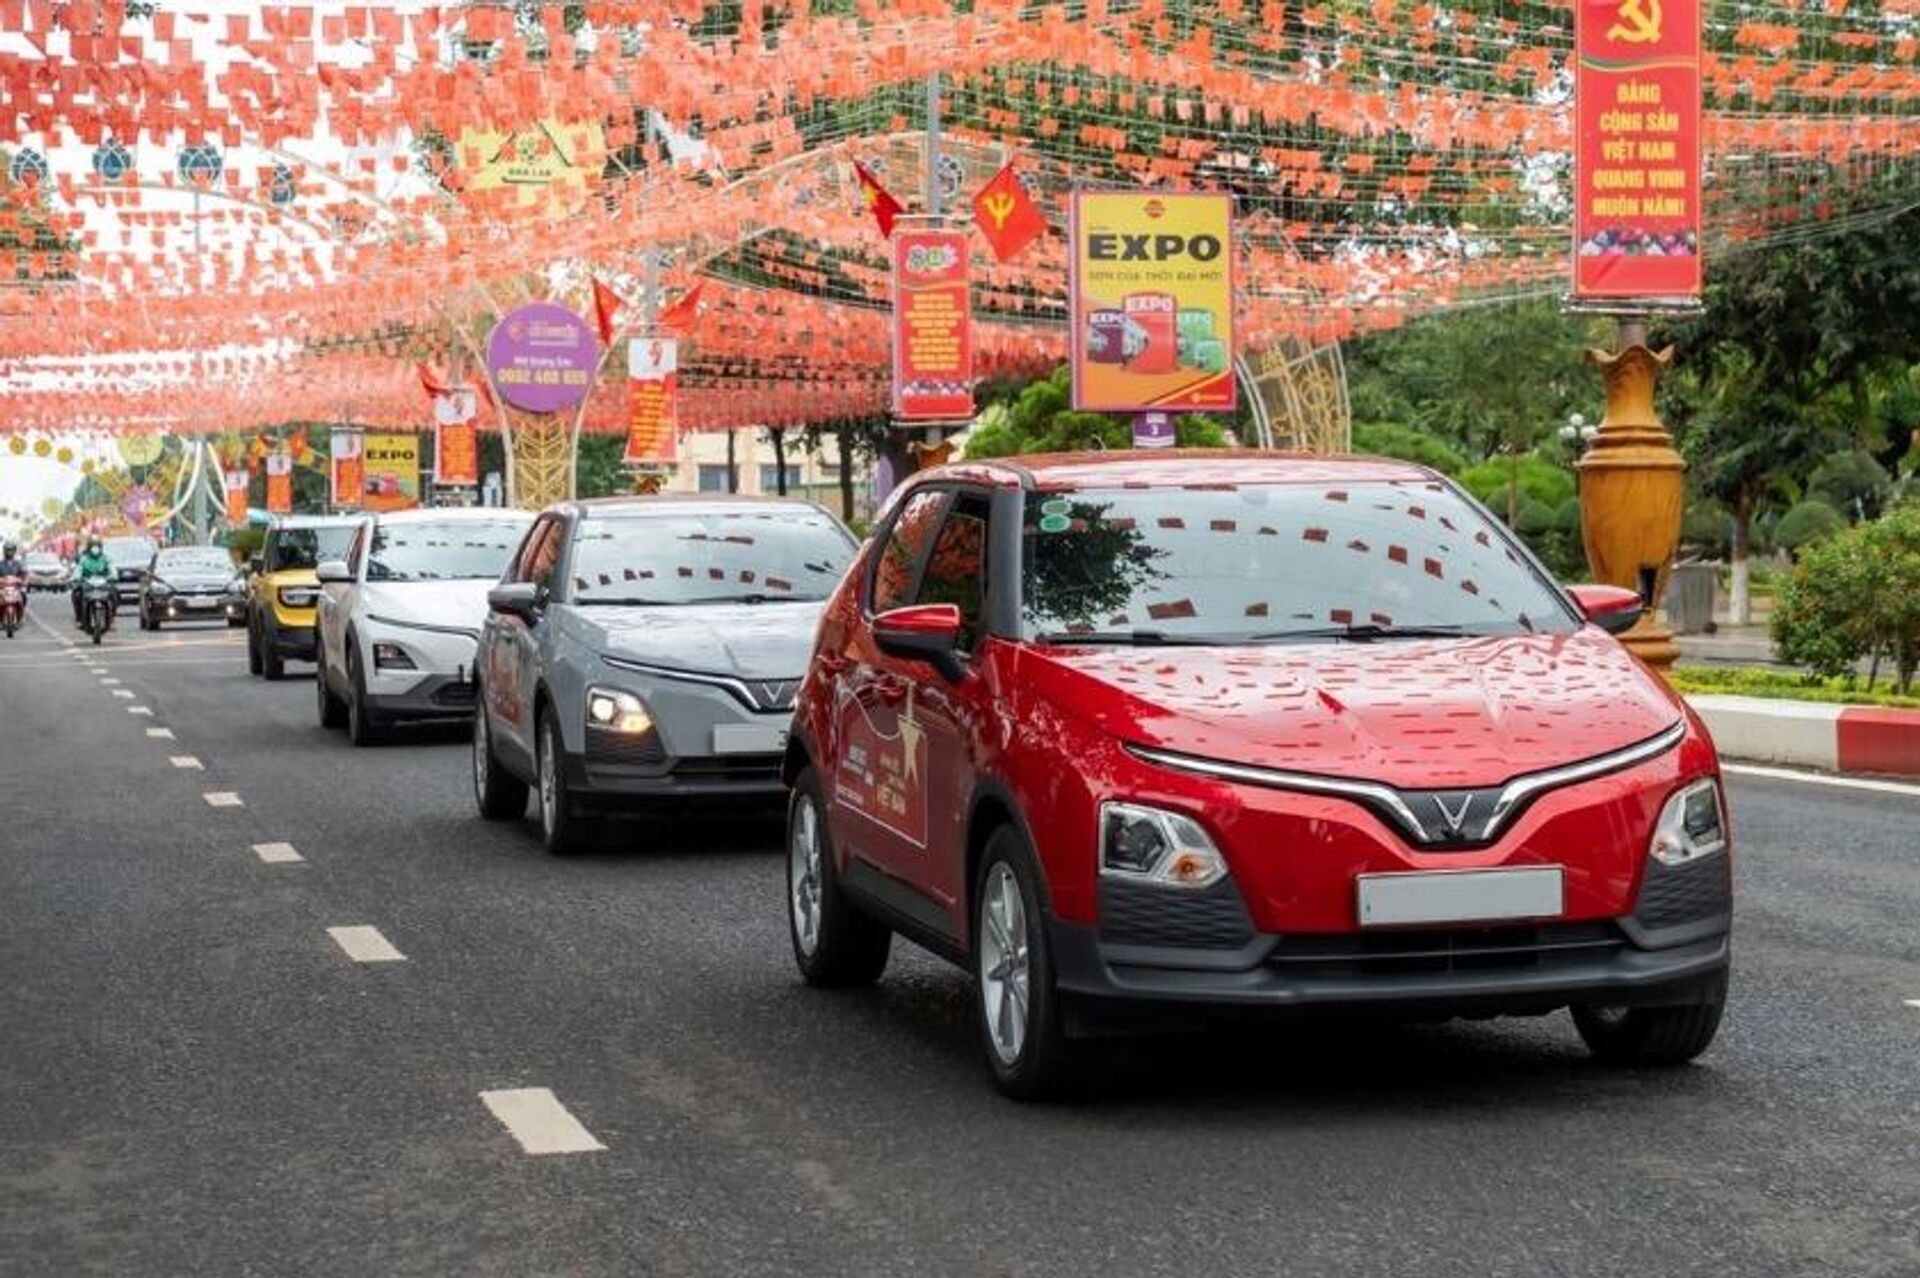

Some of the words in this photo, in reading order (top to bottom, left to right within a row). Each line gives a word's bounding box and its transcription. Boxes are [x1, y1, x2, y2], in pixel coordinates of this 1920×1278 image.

[1600, 109, 1642, 135] CỘNG
[1646, 107, 1679, 131] SẢN
[1602, 138, 1635, 163] VIỆT
[1639, 142, 1675, 160] NAM
[1593, 169, 1644, 190] QUANG
[1649, 170, 1685, 188] VINH
[1089, 233, 1221, 262] EXPO
[366, 450, 415, 461] EXPO
